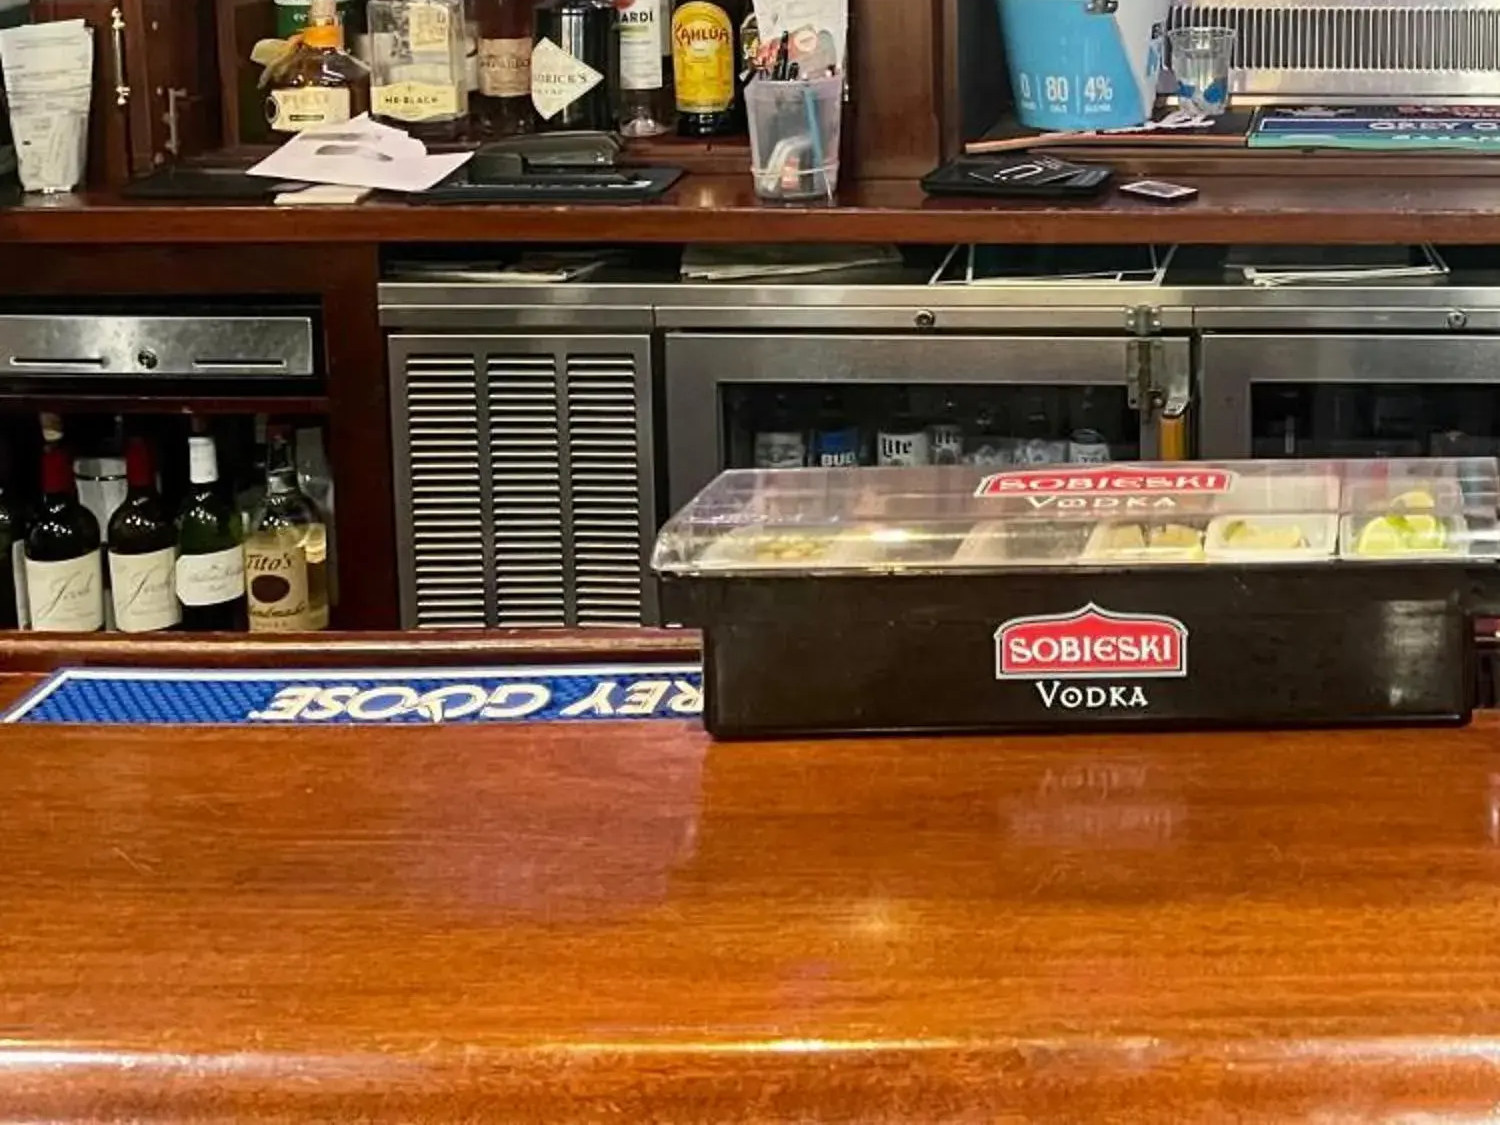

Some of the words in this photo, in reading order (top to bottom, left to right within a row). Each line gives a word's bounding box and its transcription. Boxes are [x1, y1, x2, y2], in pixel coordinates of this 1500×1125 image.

[1045, 75, 1069, 102] 80
[1084, 75, 1114, 103] 4%
[1368, 121, 1460, 131] GREY
[881, 434, 912, 458] Lite
[997, 473, 1218, 491] SOBIESKI
[247, 551, 292, 571] Tito's
[1009, 634, 1173, 664] SOBIESKI
[250, 683, 551, 724] GOOSE
[562, 680, 704, 716] REY
